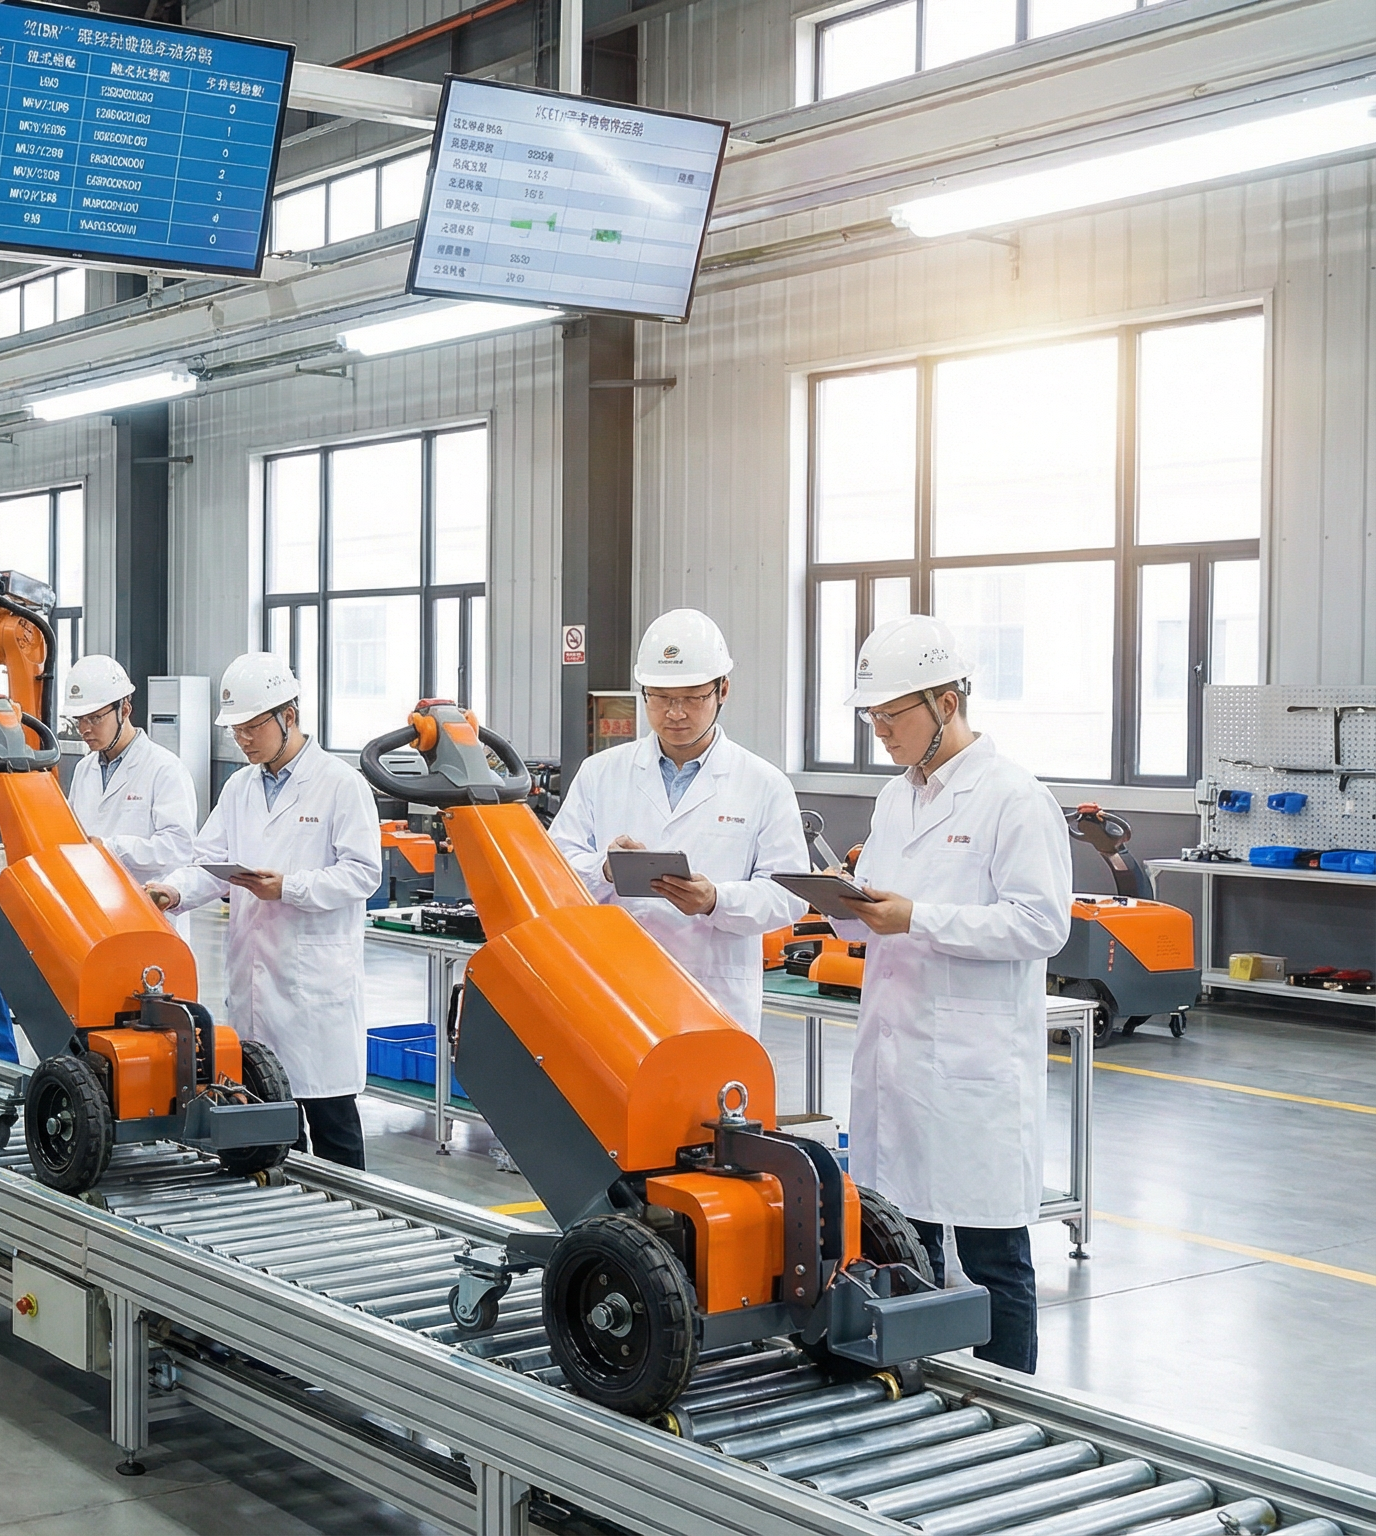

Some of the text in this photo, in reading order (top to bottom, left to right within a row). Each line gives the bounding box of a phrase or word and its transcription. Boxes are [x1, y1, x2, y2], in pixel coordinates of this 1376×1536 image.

[229, 103, 236, 115] 0
[222, 148, 229, 158] 0
[215, 190, 222, 202] 3
[209, 233, 217, 245] 0
